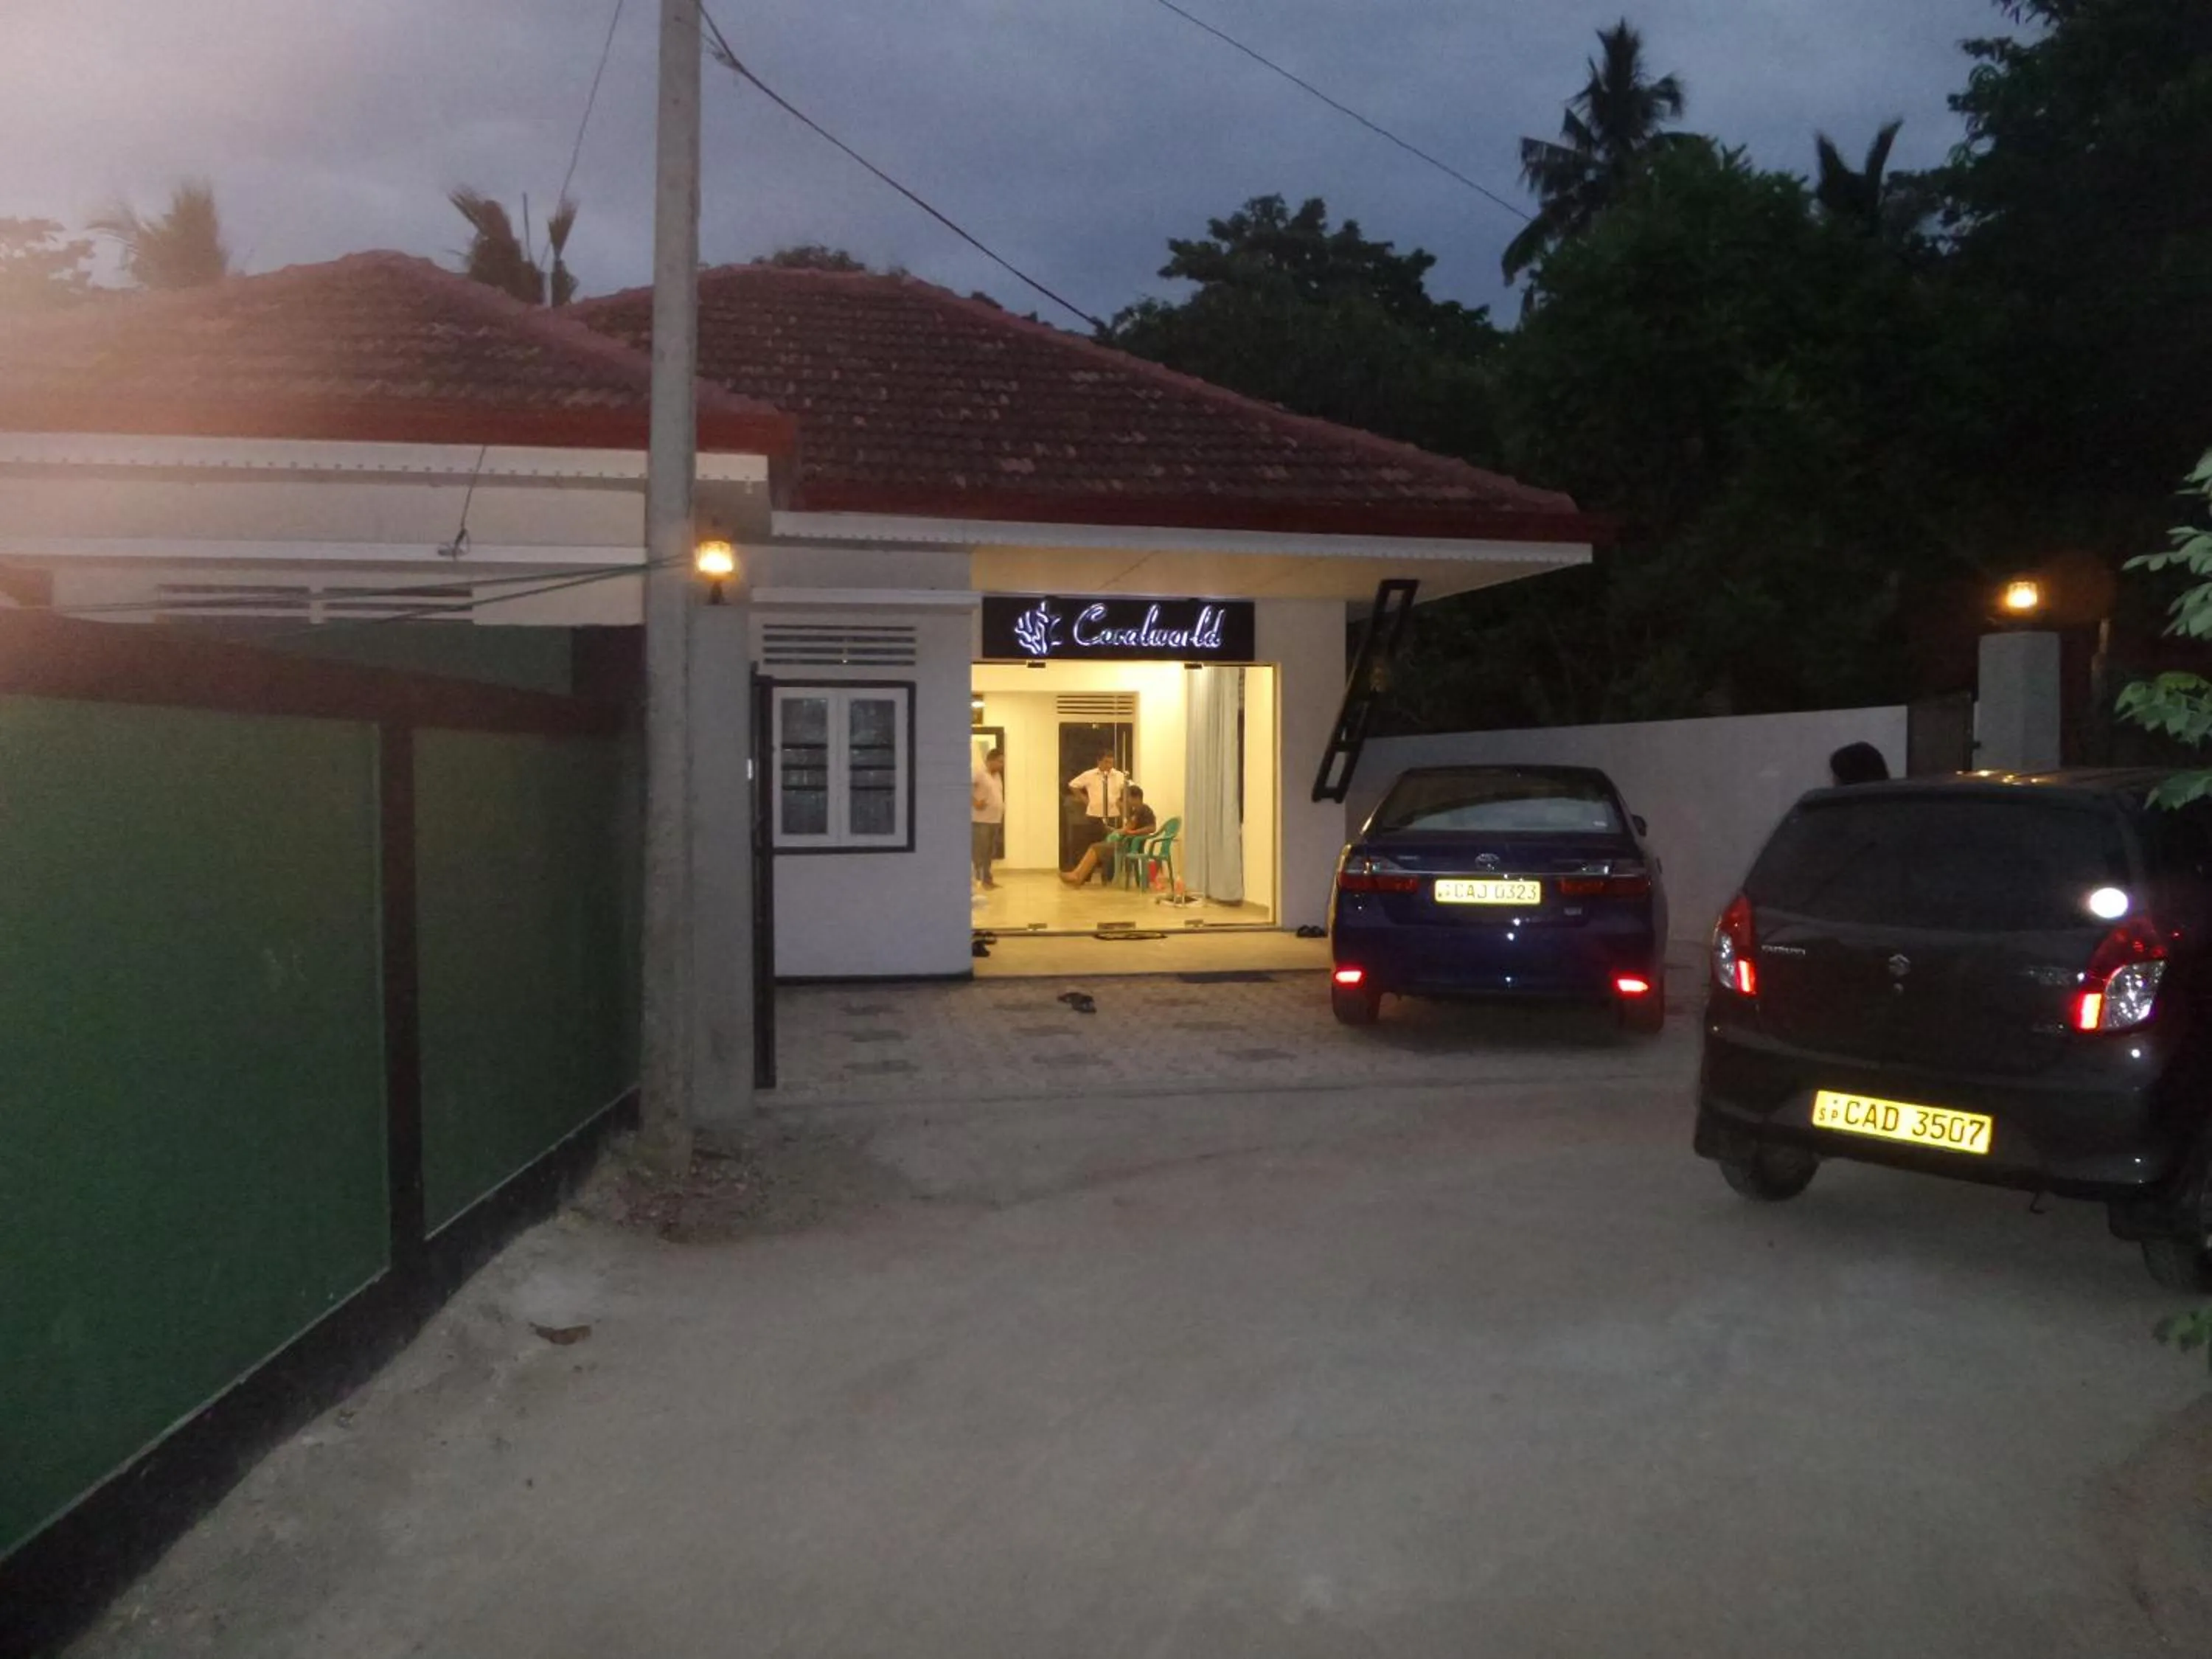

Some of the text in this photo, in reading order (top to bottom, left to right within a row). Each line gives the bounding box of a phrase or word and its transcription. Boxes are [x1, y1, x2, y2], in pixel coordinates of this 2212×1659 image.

[1073, 602, 1226, 648] Coralworld
[1454, 884, 1488, 900] CAJ
[1495, 884, 1537, 900] 0323
[1844, 1101, 1899, 1132] CAD
[1912, 1110, 1986, 1146] 3507
